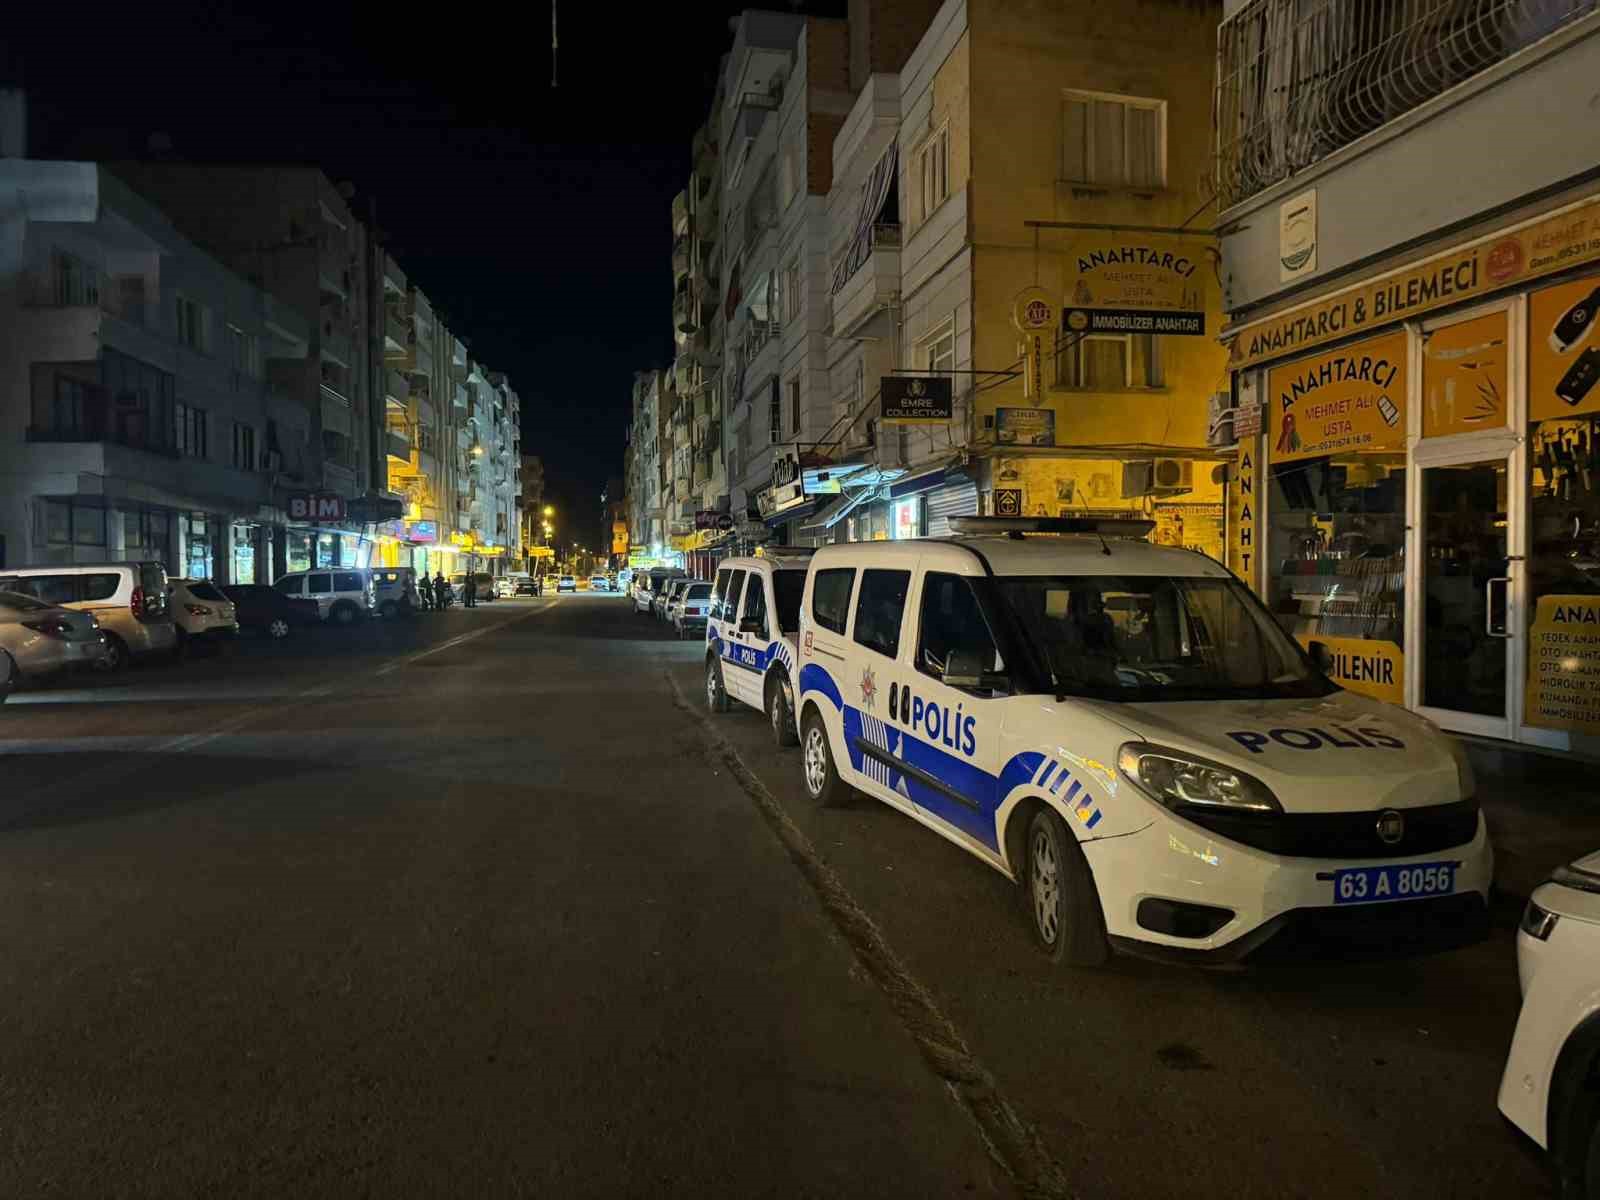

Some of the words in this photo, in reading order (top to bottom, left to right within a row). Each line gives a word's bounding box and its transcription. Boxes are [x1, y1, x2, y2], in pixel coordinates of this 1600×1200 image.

[1077, 247, 1196, 278] ANAHTARCI
[1249, 304, 1346, 358] ANAHTARCI
[1353, 298, 1366, 324] &
[1374, 252, 1477, 317] BİLEMECİ
[1156, 315, 1199, 331] ANAHTAR
[1281, 357, 1397, 411] ANAHTARCI
[886, 408, 948, 417] COLLECTION
[901, 399, 933, 408] EMRE
[1305, 400, 1351, 420] MEHMET
[1324, 421, 1352, 436] USTA
[292, 494, 338, 517] BİM
[1553, 605, 1600, 624] ANA
[913, 695, 976, 757] POLİS
[1226, 722, 1405, 753] POLİS
[1340, 872, 1367, 898] 63
[1375, 869, 1391, 896] A
[1398, 867, 1449, 895] 8056
